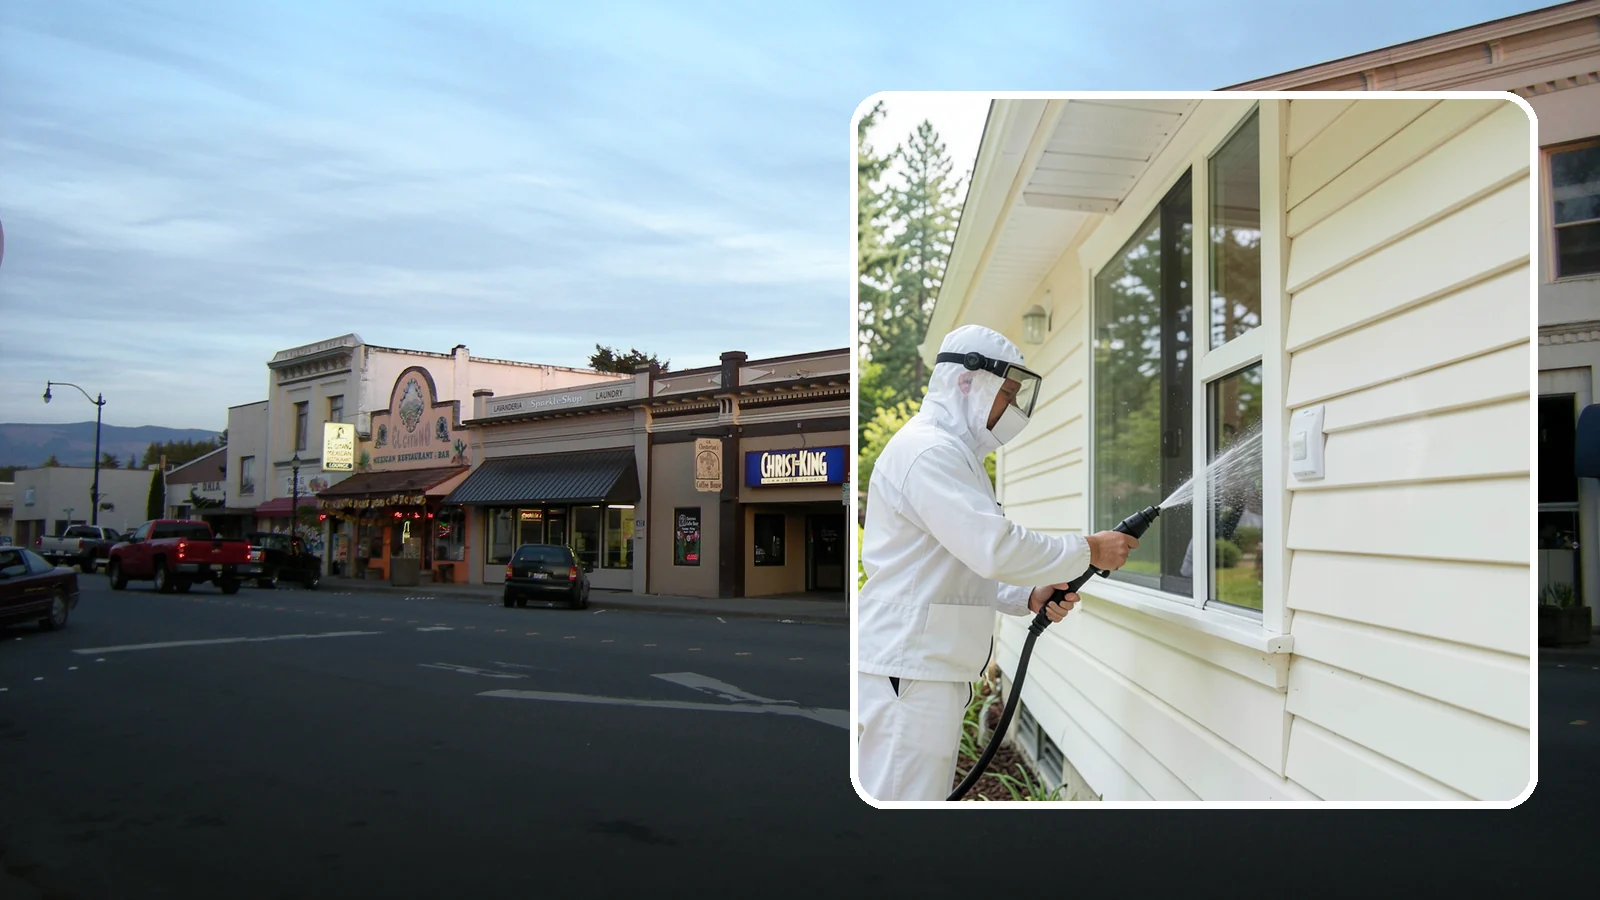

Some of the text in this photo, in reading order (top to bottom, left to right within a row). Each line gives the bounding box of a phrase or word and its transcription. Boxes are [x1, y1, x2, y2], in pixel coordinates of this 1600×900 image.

[595, 389, 624, 400] LAUNDRY
[562, 394, 583, 406] Shop
[493, 402, 523, 412] LAVANDERIA
[373, 455, 396, 464] MEXICAN
[398, 451, 434, 462] RESTAURANT
[438, 450, 450, 459] BAR
[697, 481, 722, 489] Coffee House
